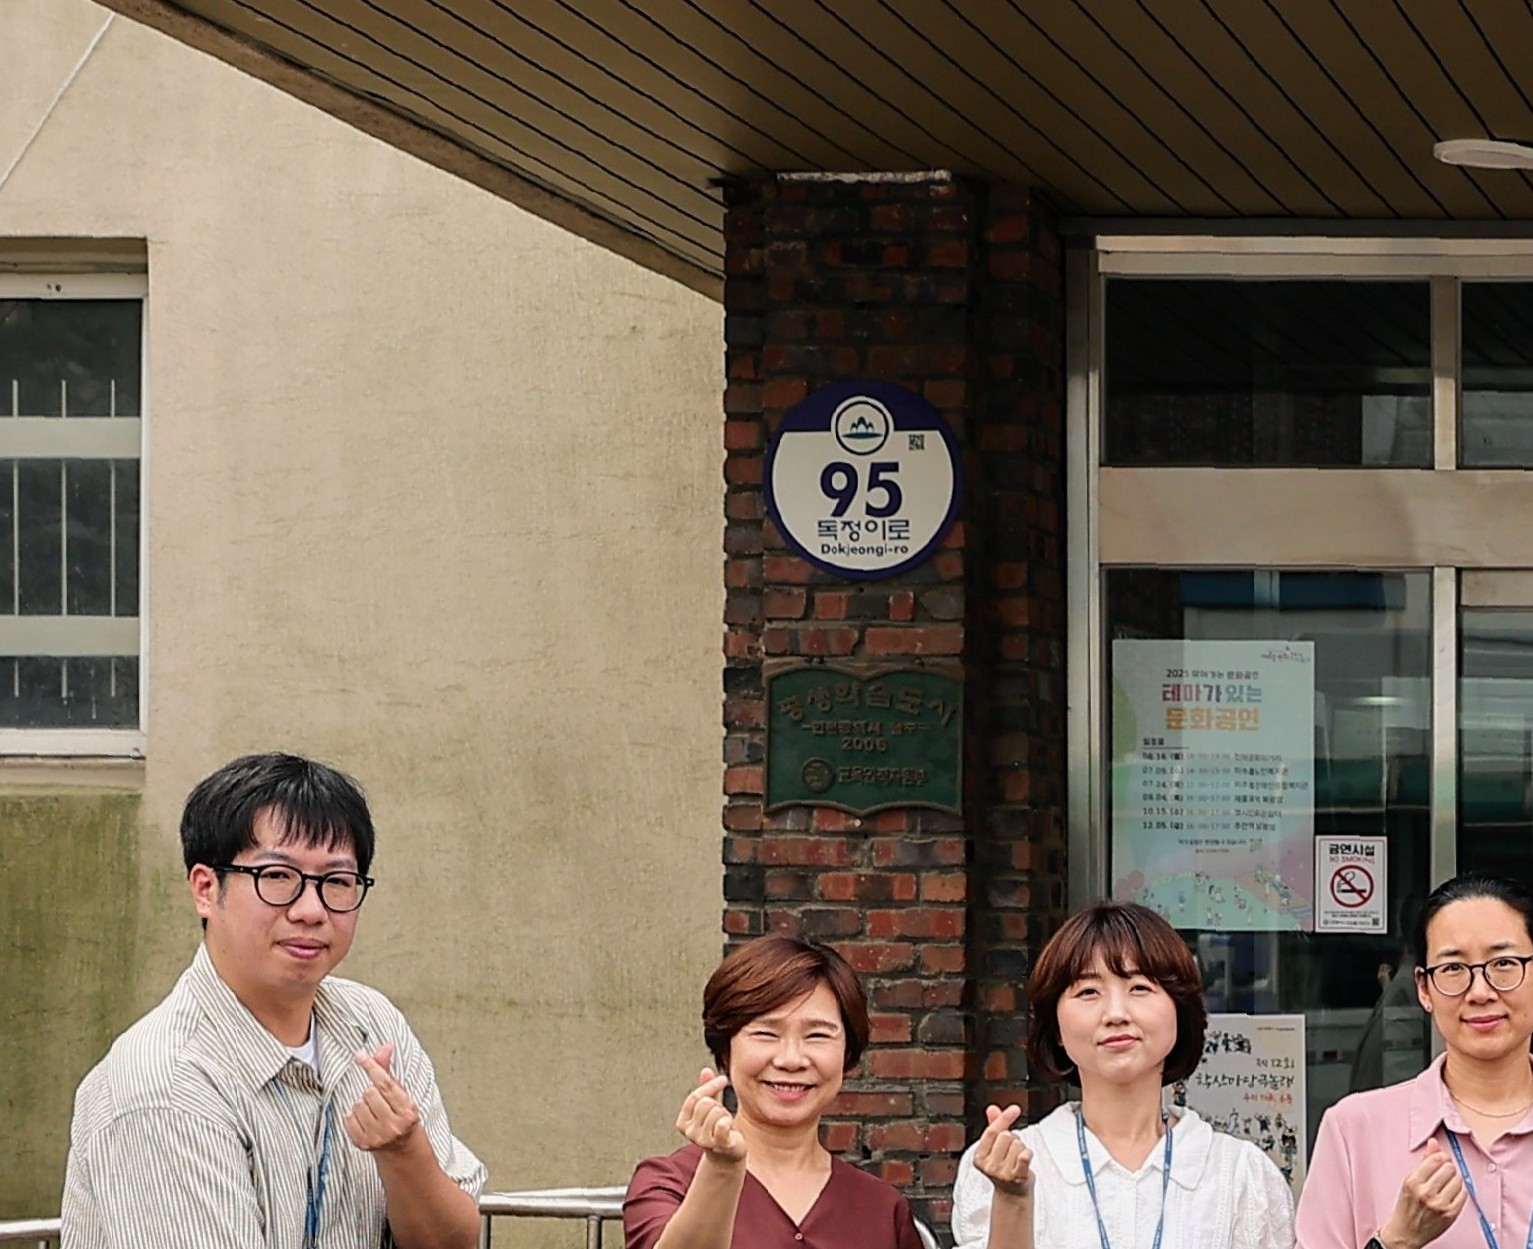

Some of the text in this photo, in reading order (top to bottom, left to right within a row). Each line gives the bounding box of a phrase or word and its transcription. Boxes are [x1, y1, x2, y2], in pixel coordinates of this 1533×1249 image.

[820, 461, 903, 518] 95
[817, 519, 910, 542] 독정이로
[821, 543, 909, 556] Dokjeongi-ro
[1162, 684, 1262, 703] 테마가 있는
[1166, 707, 1259, 730] 문화공연
[841, 736, 888, 751] 2006
[1329, 844, 1375, 856] 금연시설
